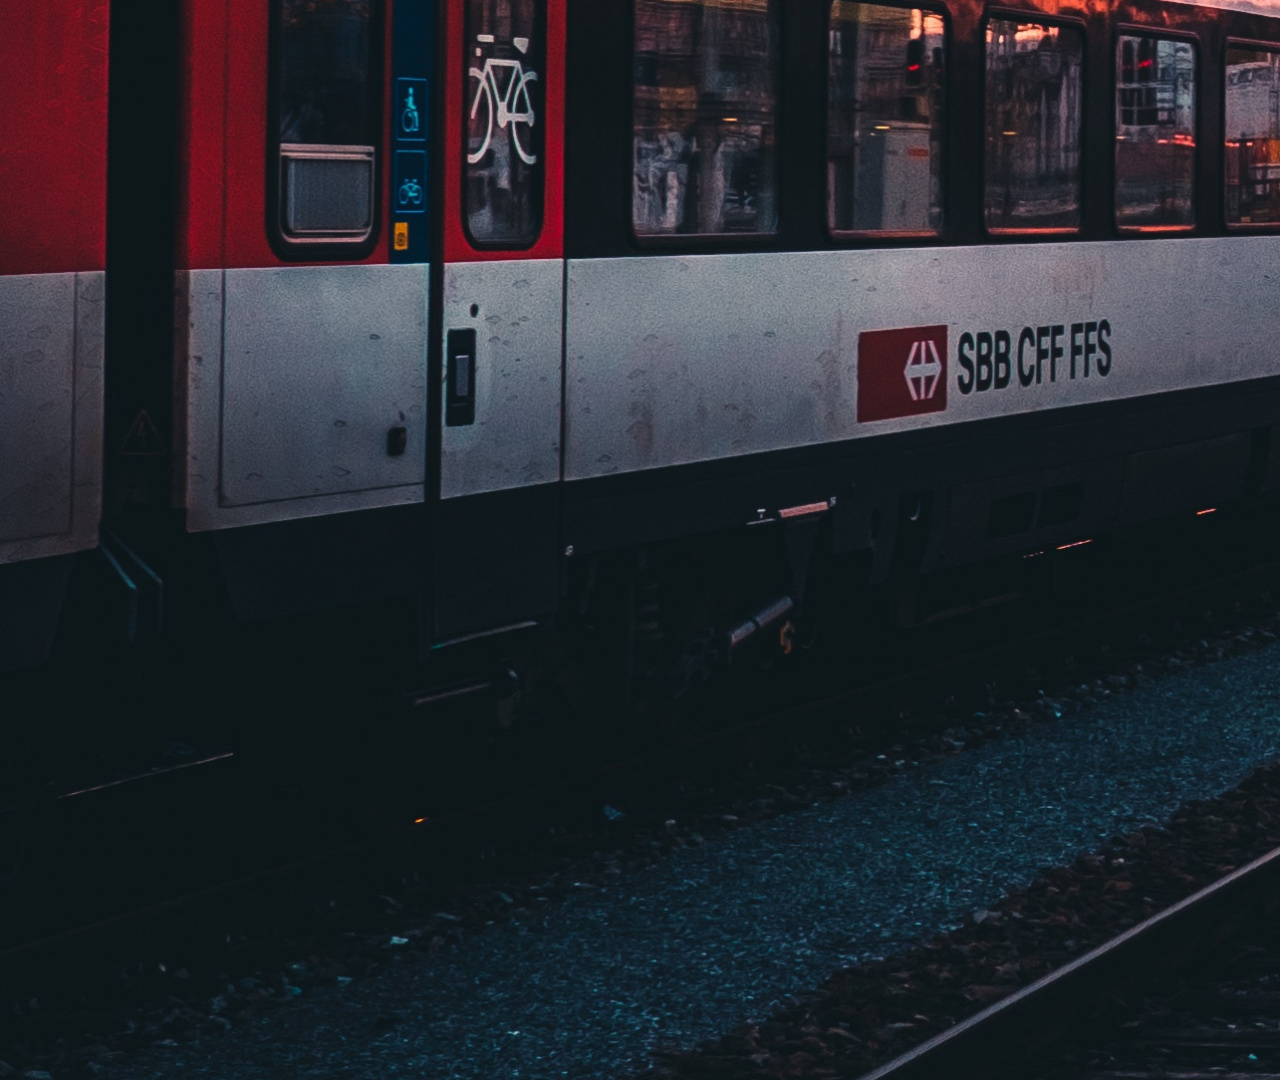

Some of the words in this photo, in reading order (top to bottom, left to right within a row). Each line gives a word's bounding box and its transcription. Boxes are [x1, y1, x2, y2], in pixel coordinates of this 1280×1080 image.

[957, 331, 1011, 395] SBB
[1017, 324, 1065, 387] CFF
[1069, 319, 1112, 380] FFS
